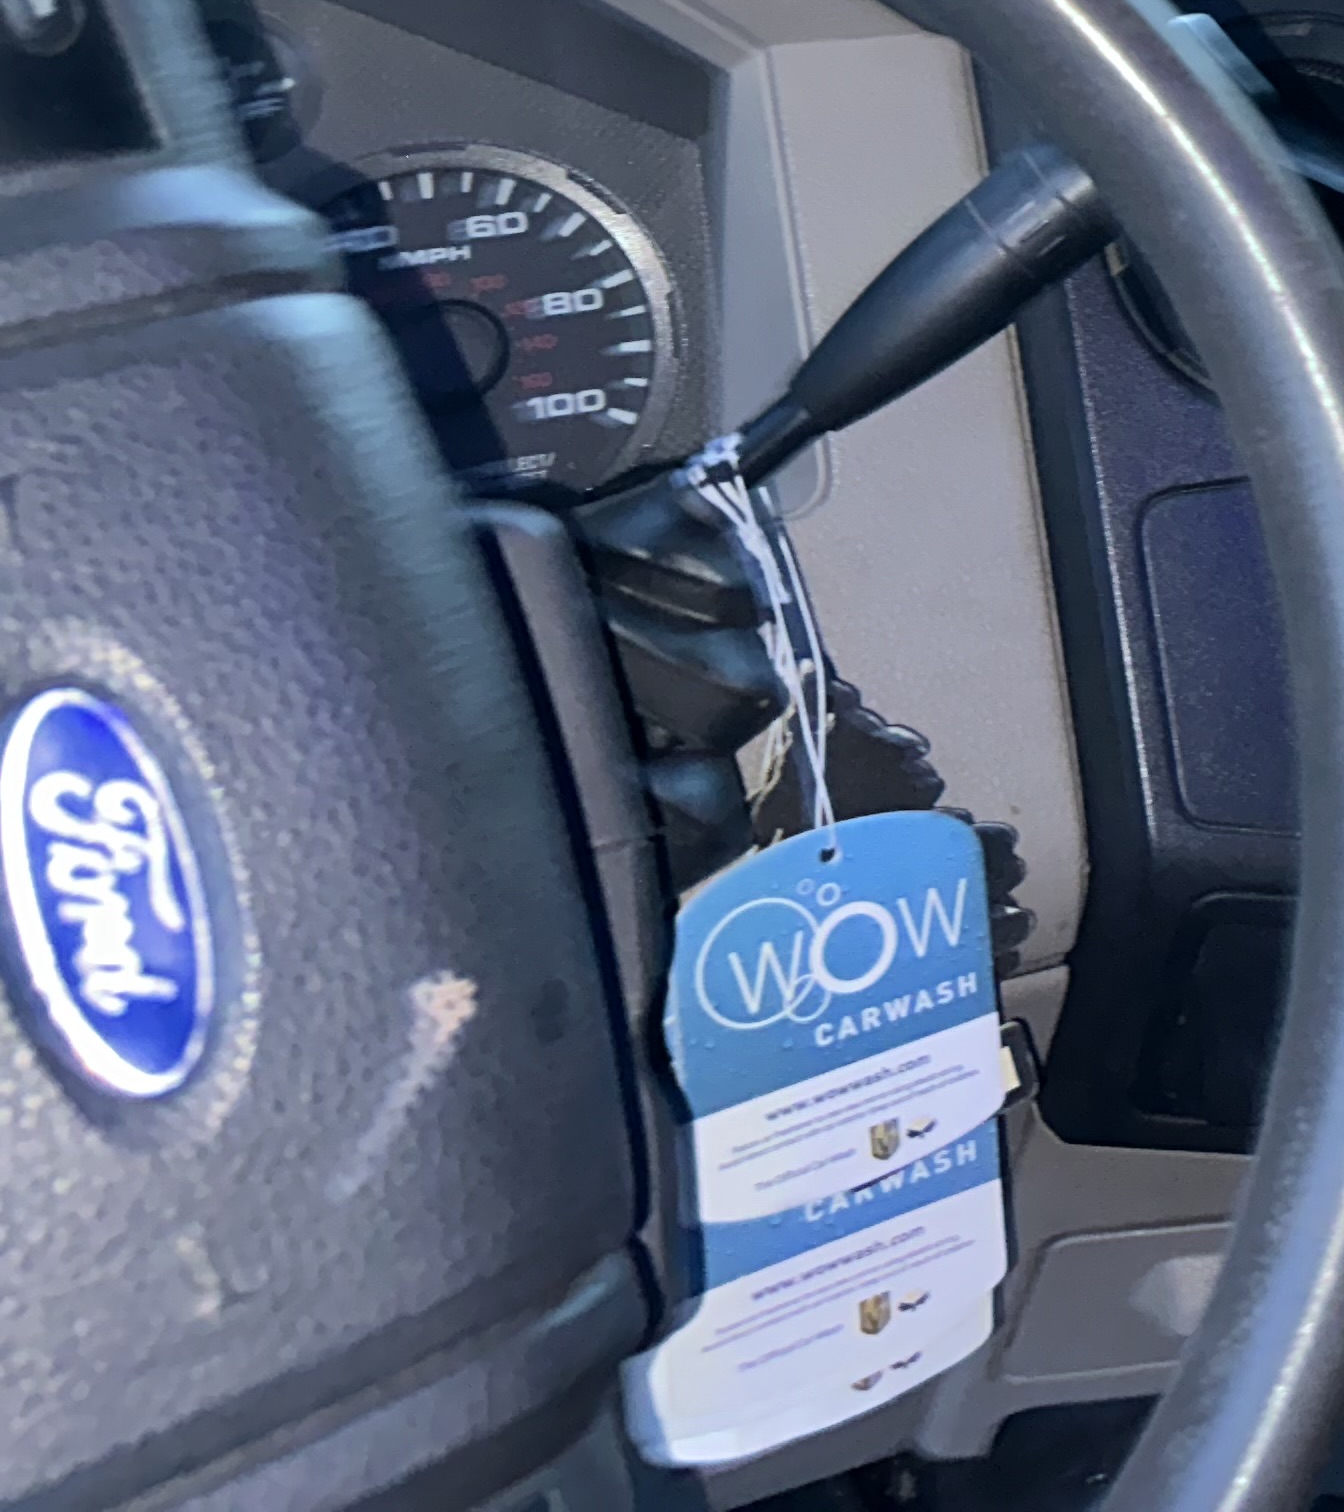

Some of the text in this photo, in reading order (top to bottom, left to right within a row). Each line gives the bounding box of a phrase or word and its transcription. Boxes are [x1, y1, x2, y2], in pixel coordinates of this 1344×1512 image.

[464, 211, 528, 240] 60
[394, 244, 472, 268] MPH
[541, 286, 604, 317] 80
[524, 387, 606, 421] 100
[29, 770, 184, 1018] Ford
[724, 877, 968, 1018] WOW
[813, 971, 978, 1048] CARWASH
